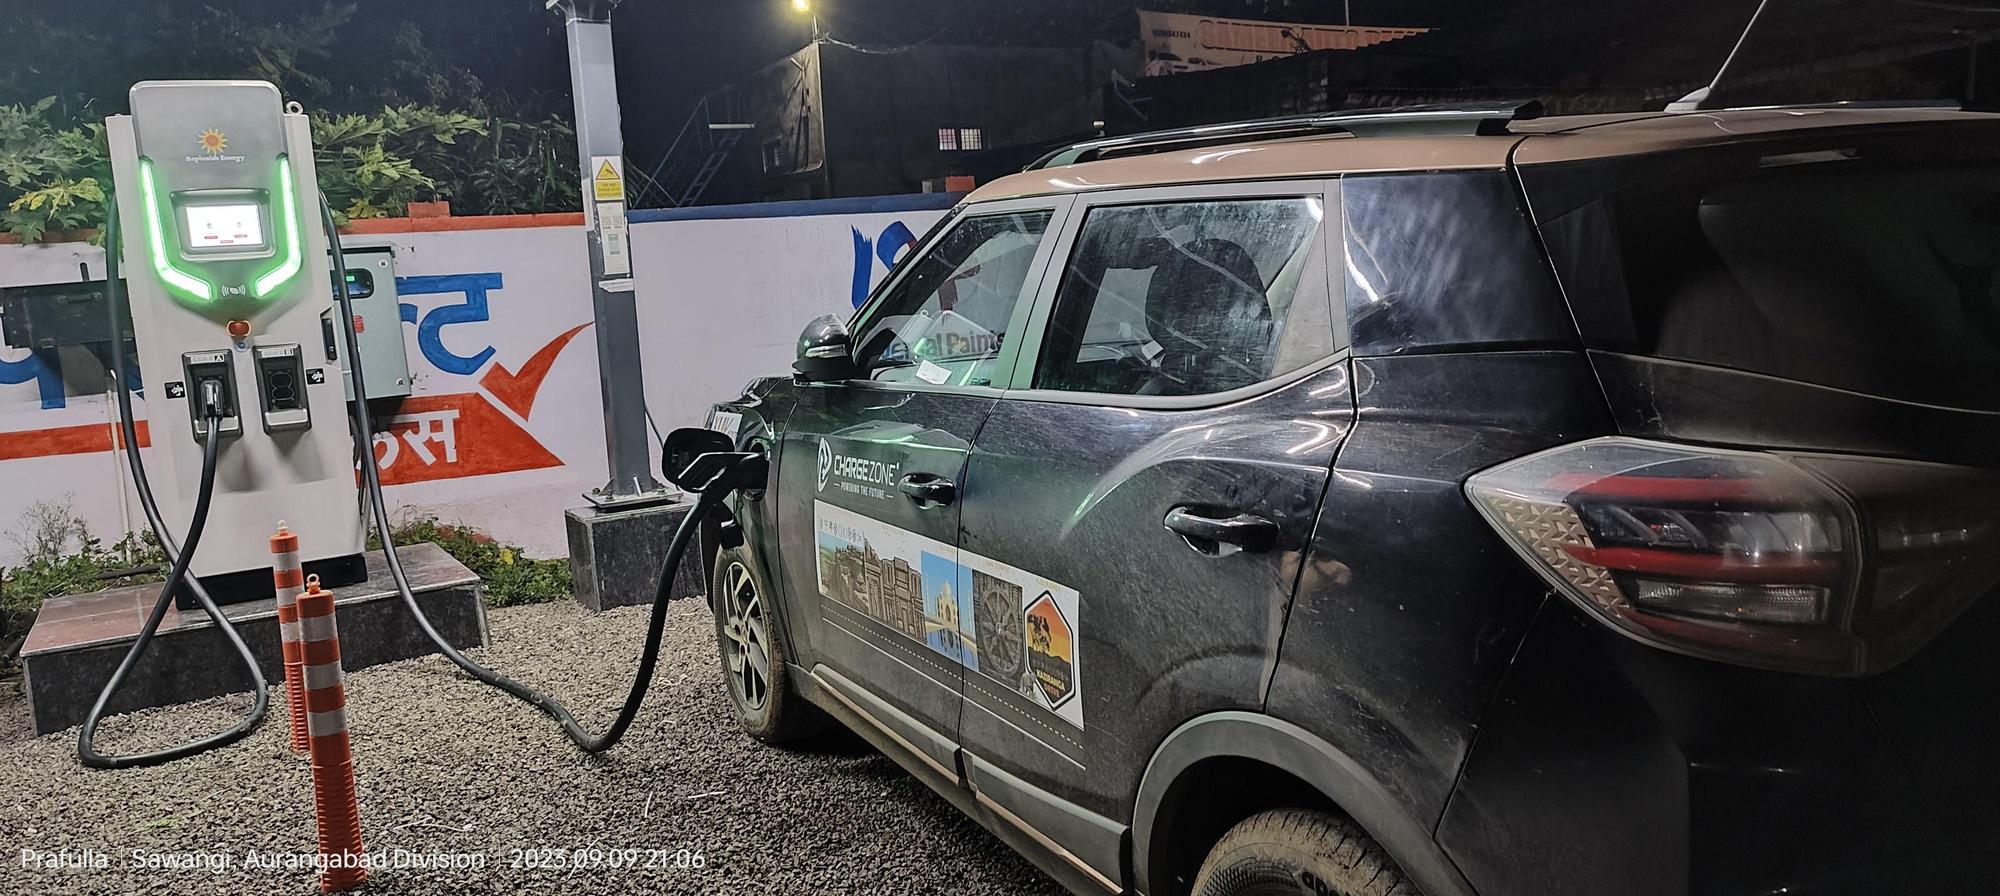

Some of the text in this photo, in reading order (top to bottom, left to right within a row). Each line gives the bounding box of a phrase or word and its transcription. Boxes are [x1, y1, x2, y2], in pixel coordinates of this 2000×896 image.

[185, 154, 245, 163] Replenish Energy
[860, 485, 868, 496] THE
[868, 487, 885, 500] FUTURE
